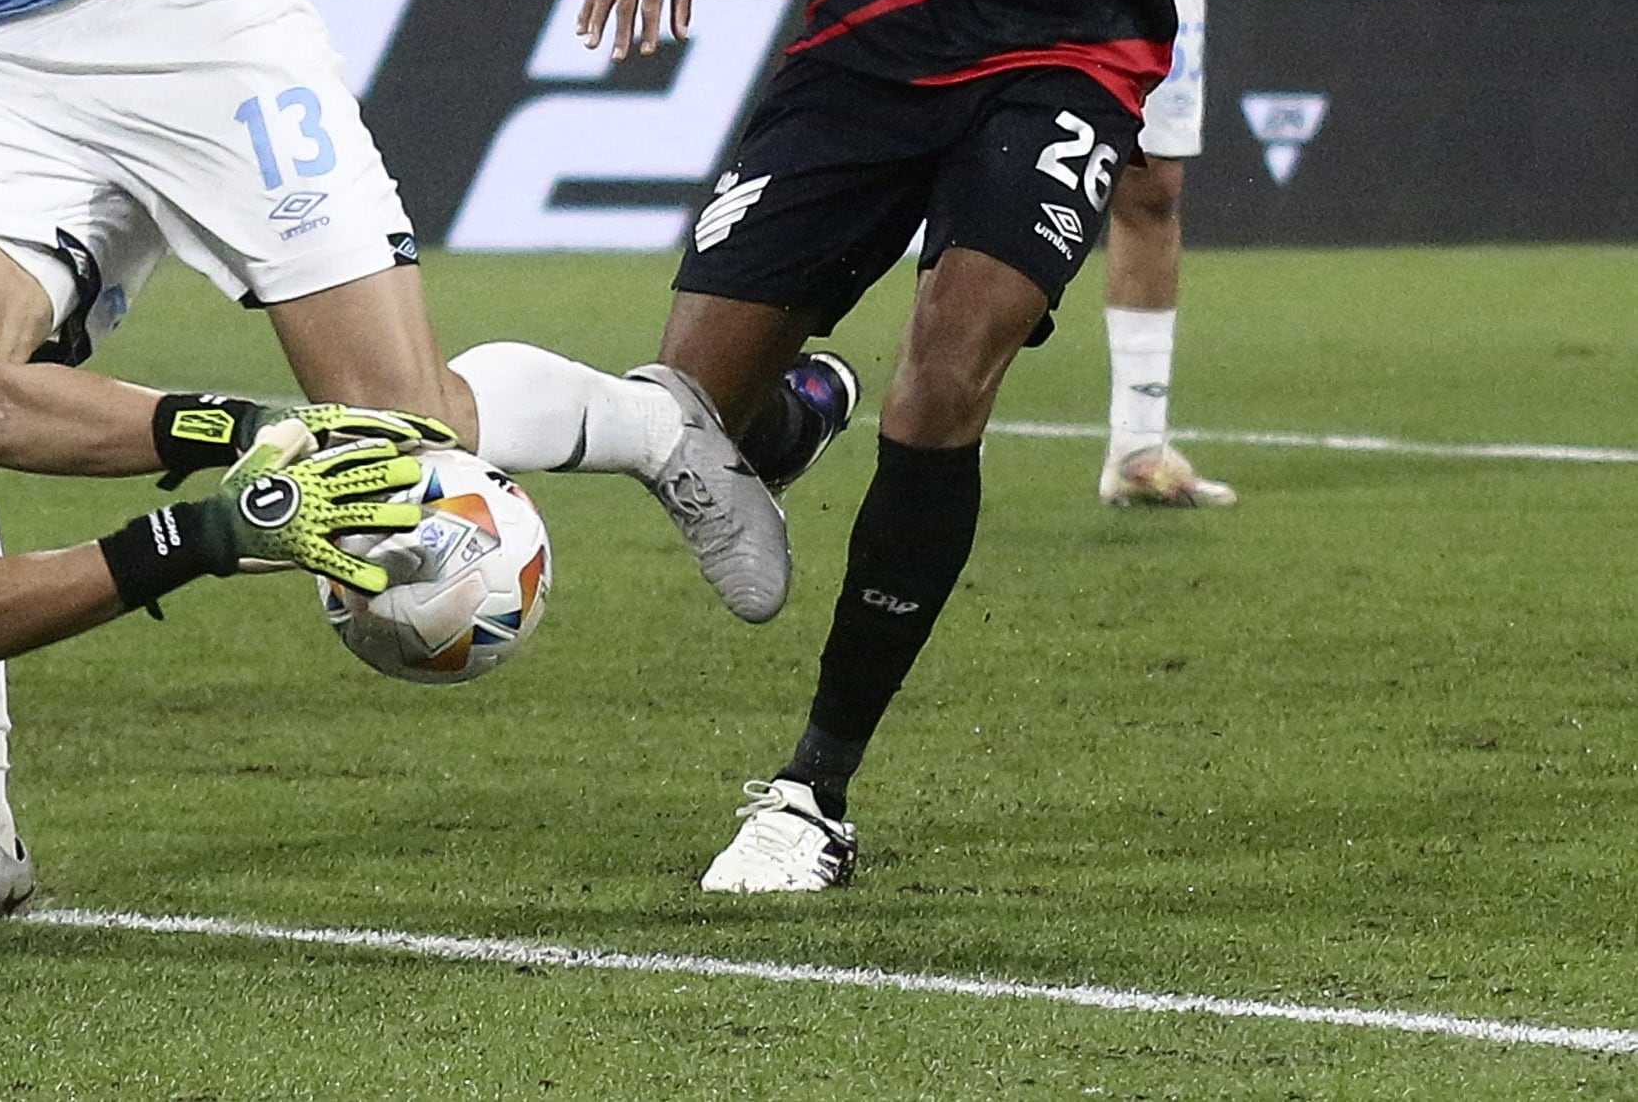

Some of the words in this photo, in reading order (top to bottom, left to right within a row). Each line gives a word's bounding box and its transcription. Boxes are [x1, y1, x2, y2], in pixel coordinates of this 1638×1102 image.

[233, 86, 336, 191] 13
[1035, 110, 1119, 213] 26
[279, 216, 331, 241] umbro
